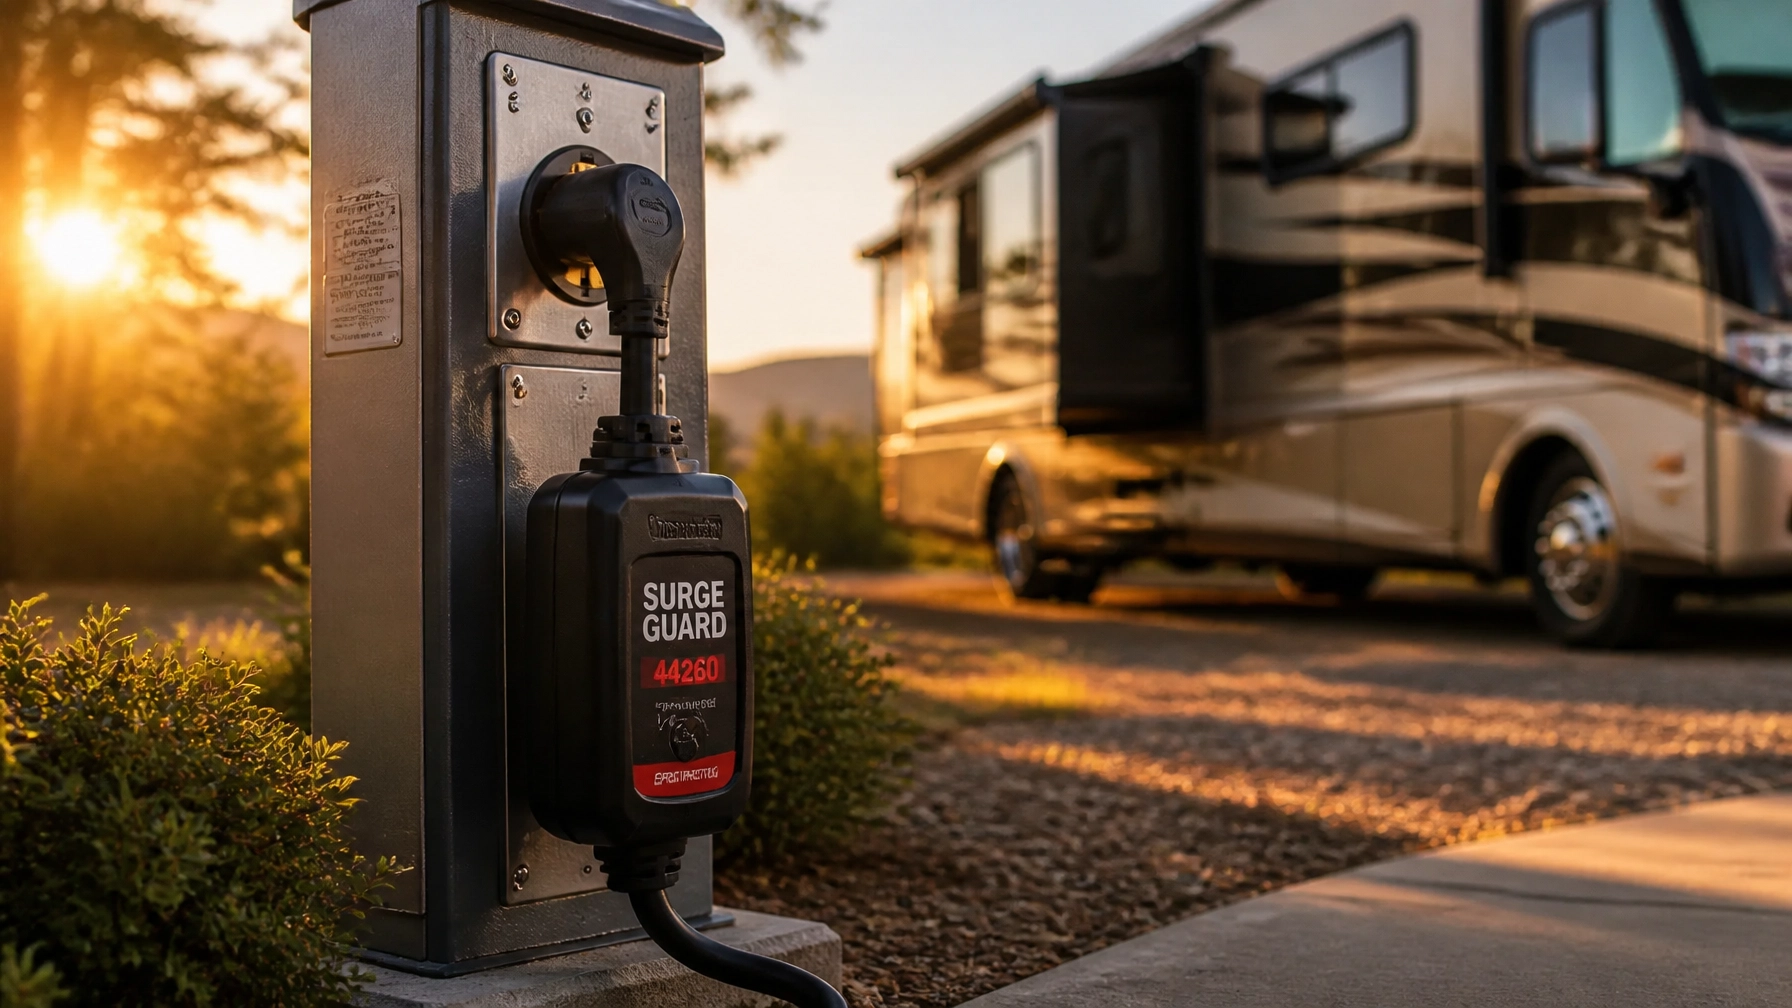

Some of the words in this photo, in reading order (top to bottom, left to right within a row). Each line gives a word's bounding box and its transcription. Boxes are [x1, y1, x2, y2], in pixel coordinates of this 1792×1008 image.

[643, 580, 725, 611] SURGE
[642, 611, 727, 642] GUARD
[653, 655, 719, 685] 44260
